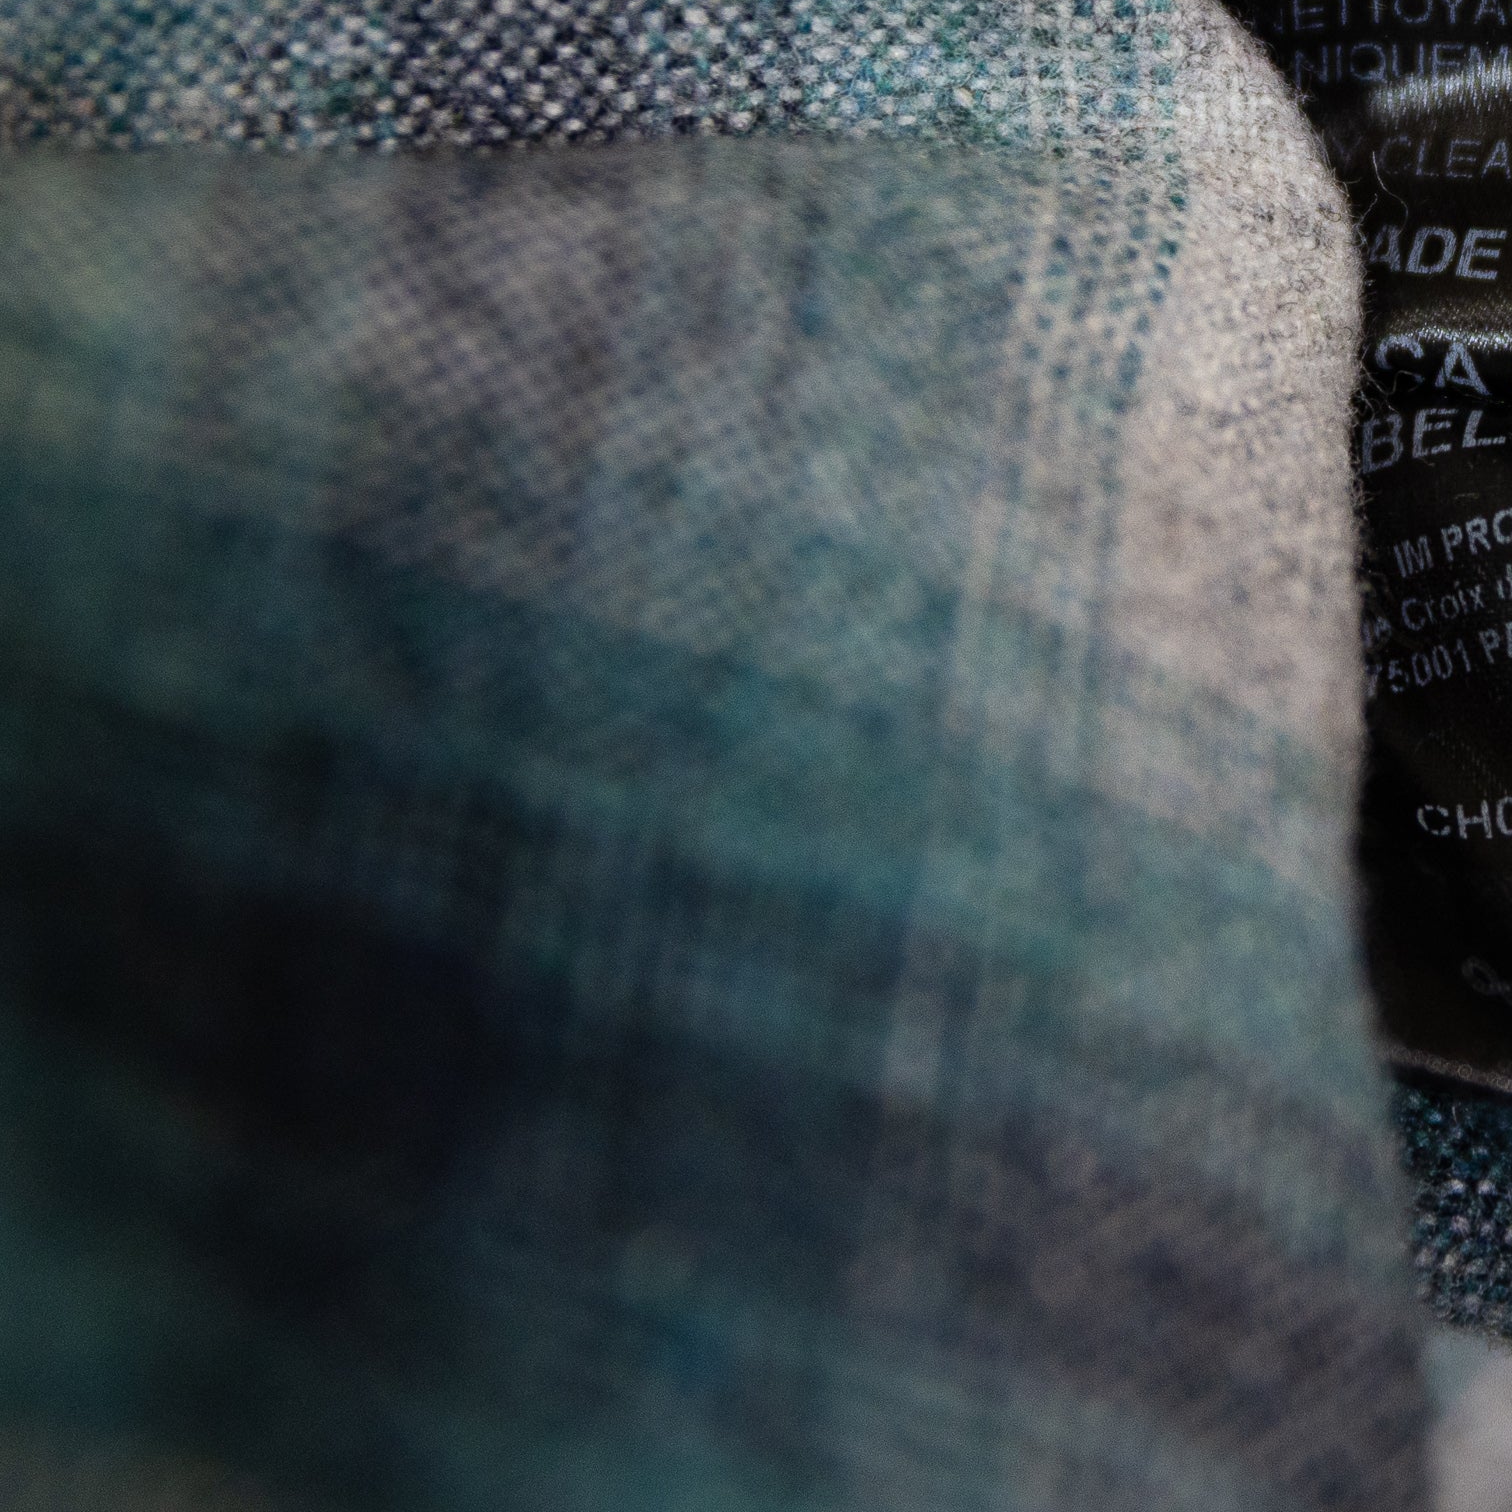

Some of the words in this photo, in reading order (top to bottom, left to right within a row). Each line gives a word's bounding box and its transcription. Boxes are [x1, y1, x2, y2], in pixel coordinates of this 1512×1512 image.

[1368, 224, 1508, 280] ADE
[1359, 407, 1508, 474] BEL
[1393, 534, 1436, 579] IM
[1400, 578, 1487, 632] Croix
